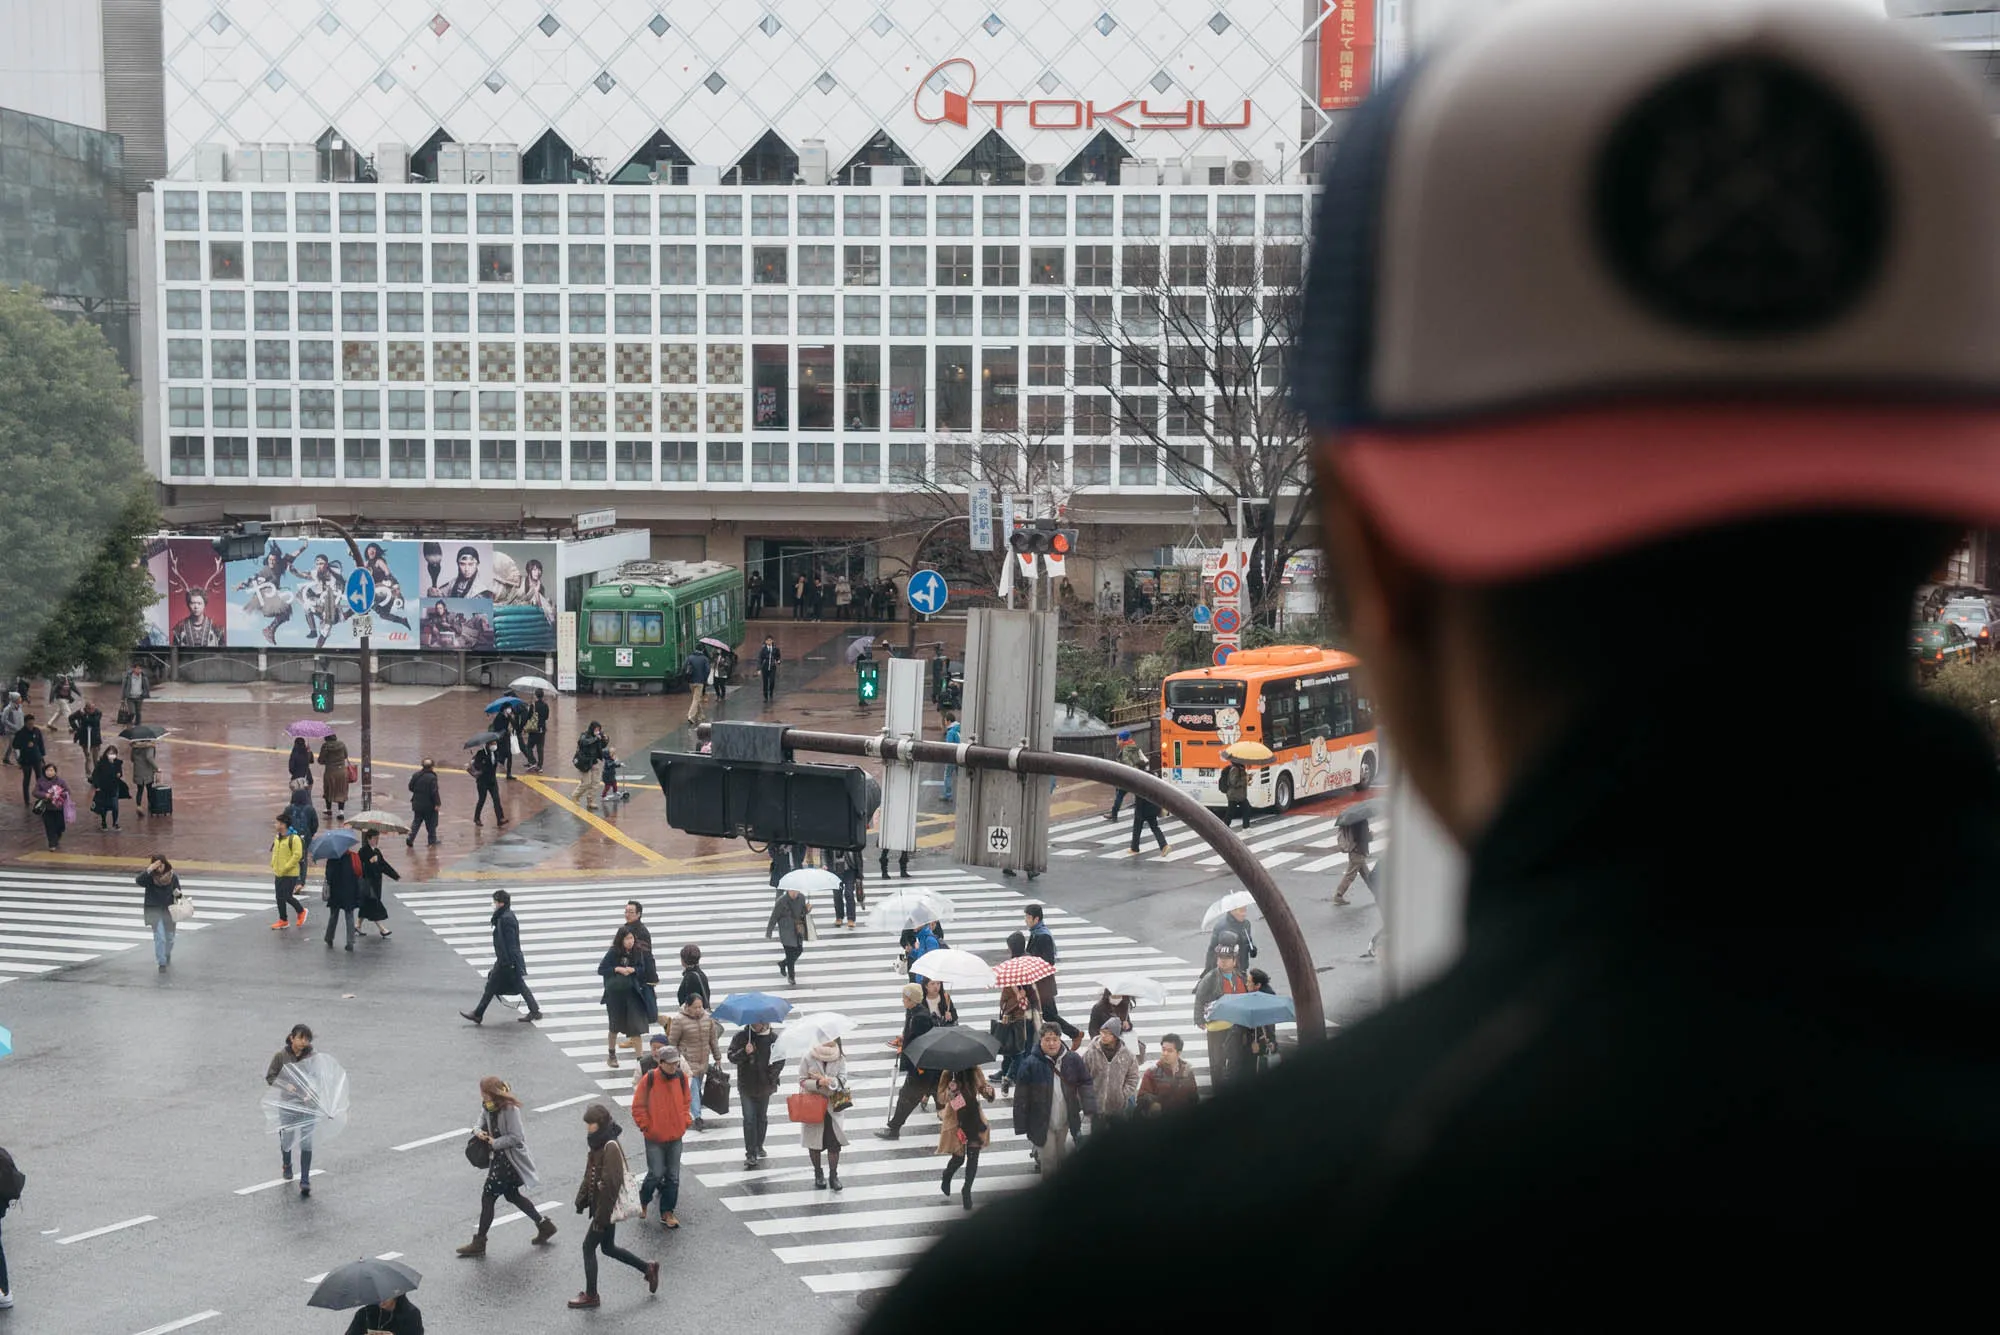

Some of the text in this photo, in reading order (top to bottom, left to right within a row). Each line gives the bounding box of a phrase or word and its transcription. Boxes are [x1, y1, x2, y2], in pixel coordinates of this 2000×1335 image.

[971, 100, 1251, 129] TOKYU
[978, 487, 990, 545] 渋谷駅前
[389, 632, 408, 641] au
